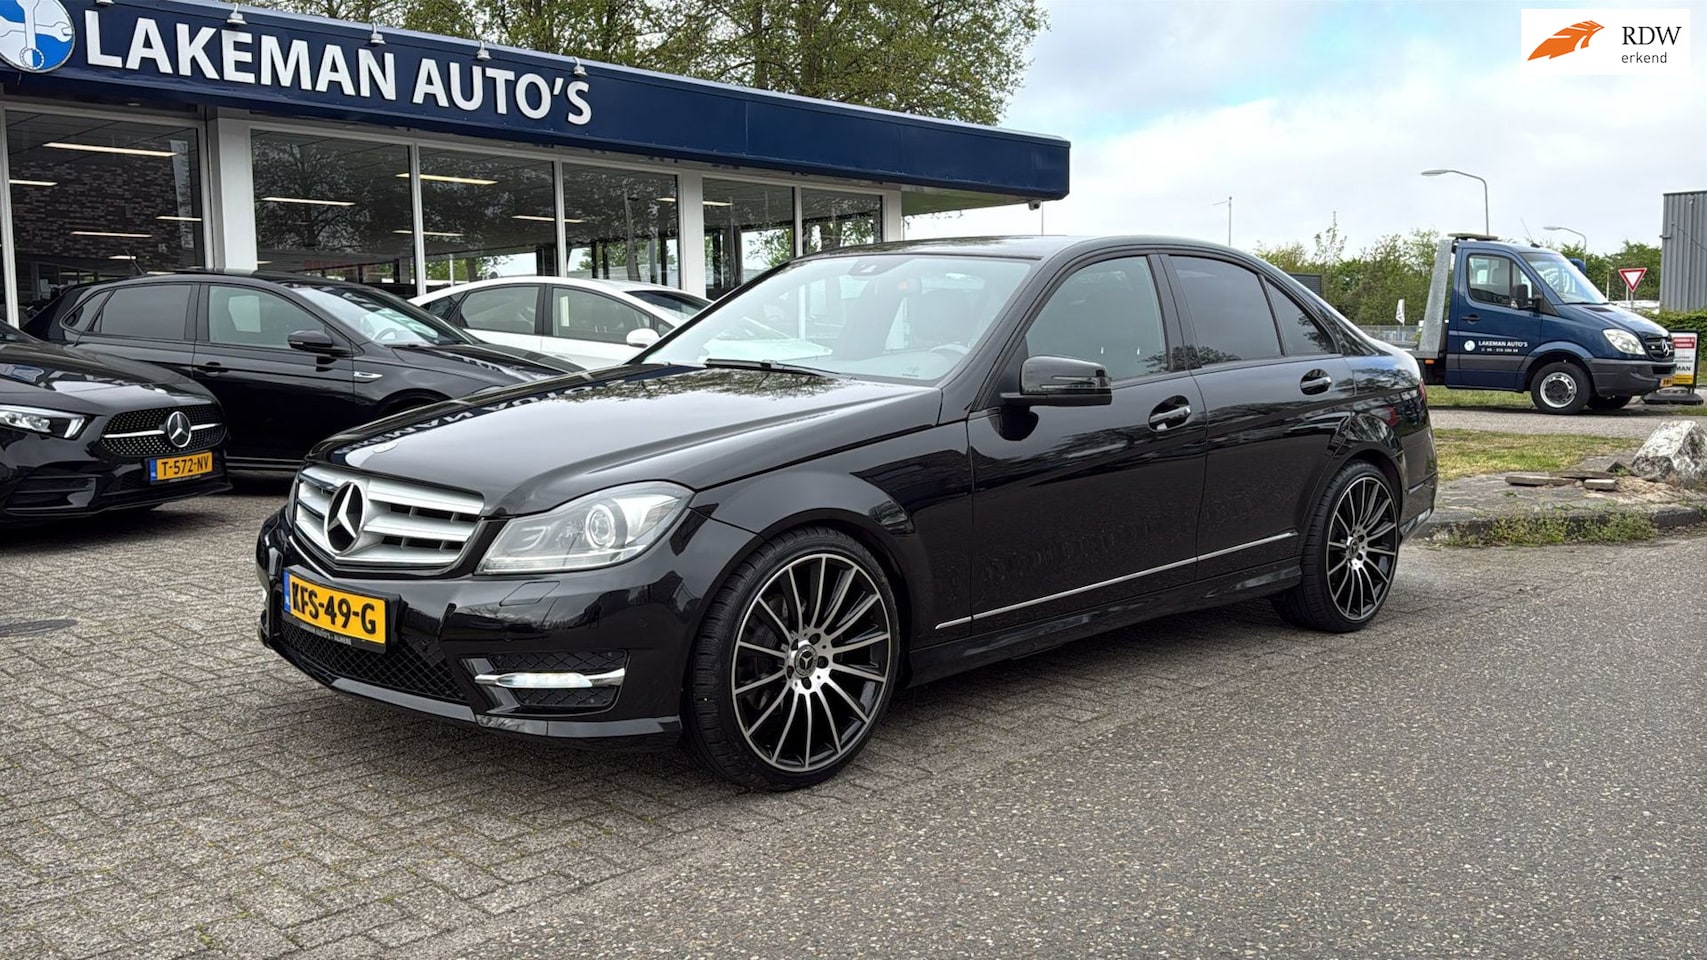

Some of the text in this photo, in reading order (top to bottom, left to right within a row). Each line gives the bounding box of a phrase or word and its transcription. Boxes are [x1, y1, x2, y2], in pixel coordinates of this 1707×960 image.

[84, 9, 593, 126] LAKEMAN AUTO'S
[161, 455, 209, 476] T-572-NV
[291, 581, 377, 635] KFS-49-G
